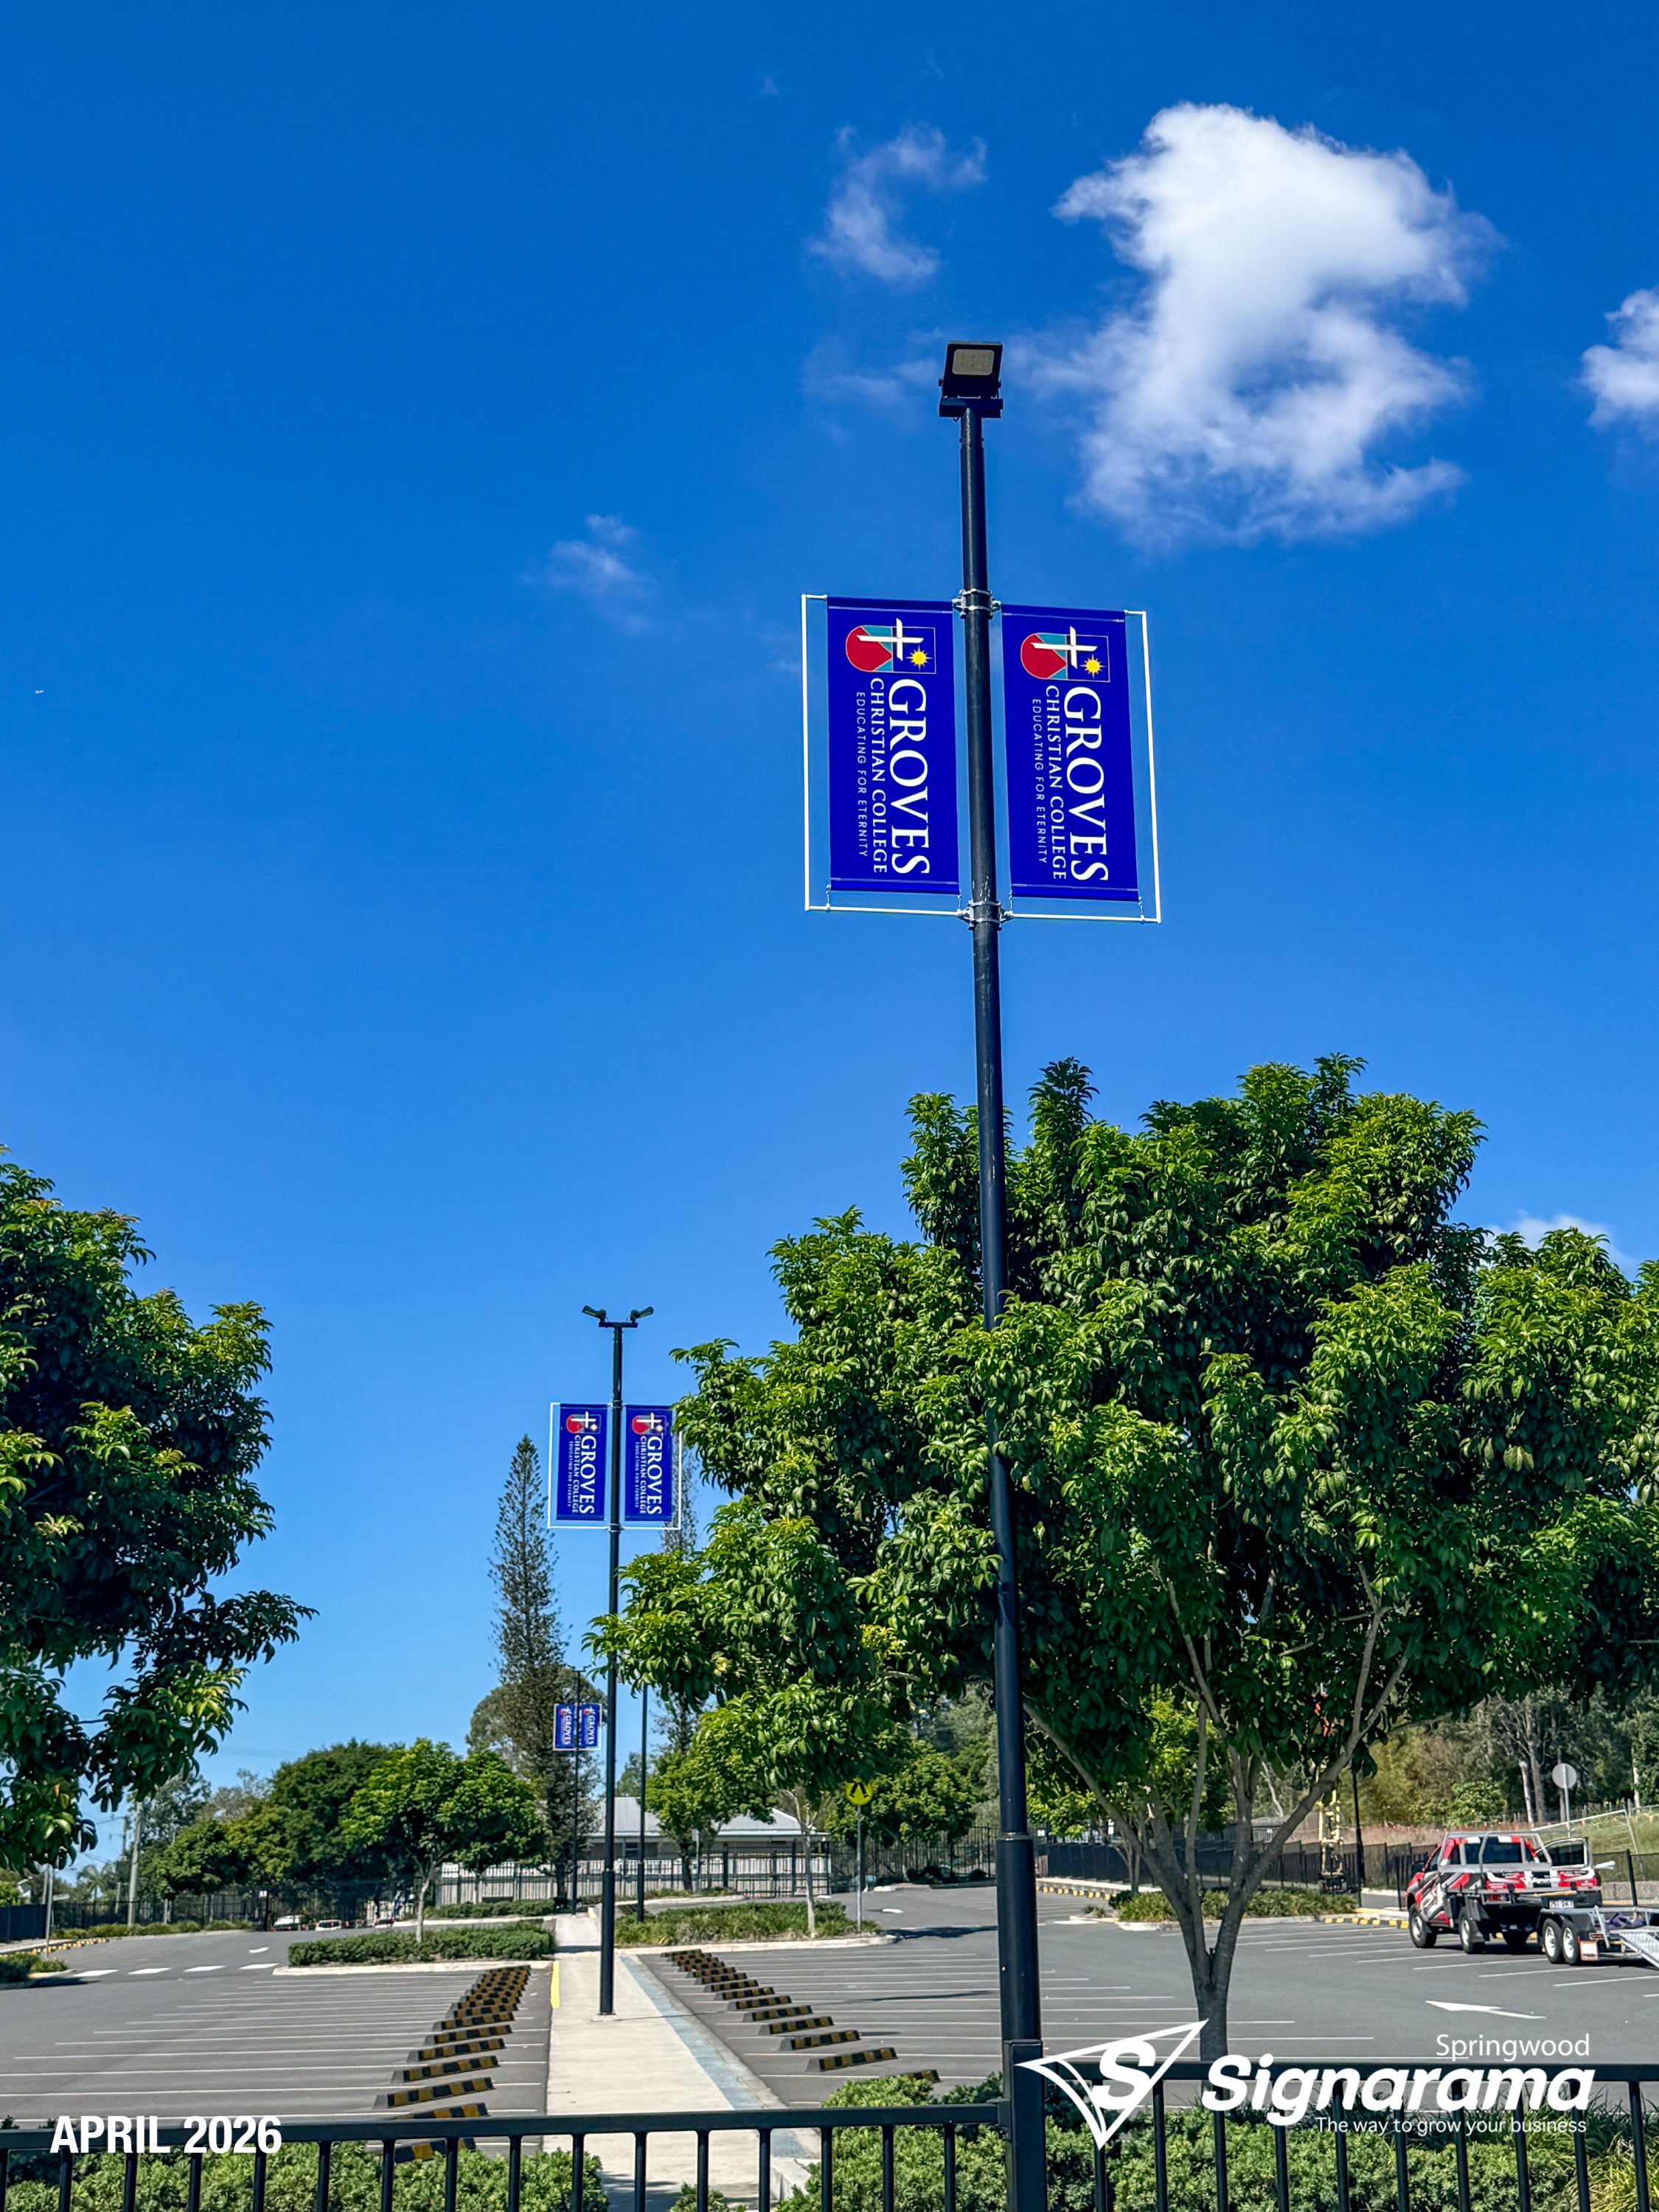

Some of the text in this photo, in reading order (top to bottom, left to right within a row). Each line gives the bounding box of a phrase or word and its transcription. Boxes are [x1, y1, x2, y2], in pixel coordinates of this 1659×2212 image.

[856, 692, 868, 857] EDUCATING FOR ETERNITY
[870, 678, 888, 873] CHRISTIAN COLLEGE
[888, 678, 930, 874] GROVES
[1032, 699, 1047, 863] EDUCATING FOR ETERNITY
[1046, 685, 1066, 880] CHRISTIAN COLLEGE
[1063, 686, 1109, 881] GROVES
[579, 1435, 597, 1514] GROVES
[647, 1436, 663, 1514] GROVES
